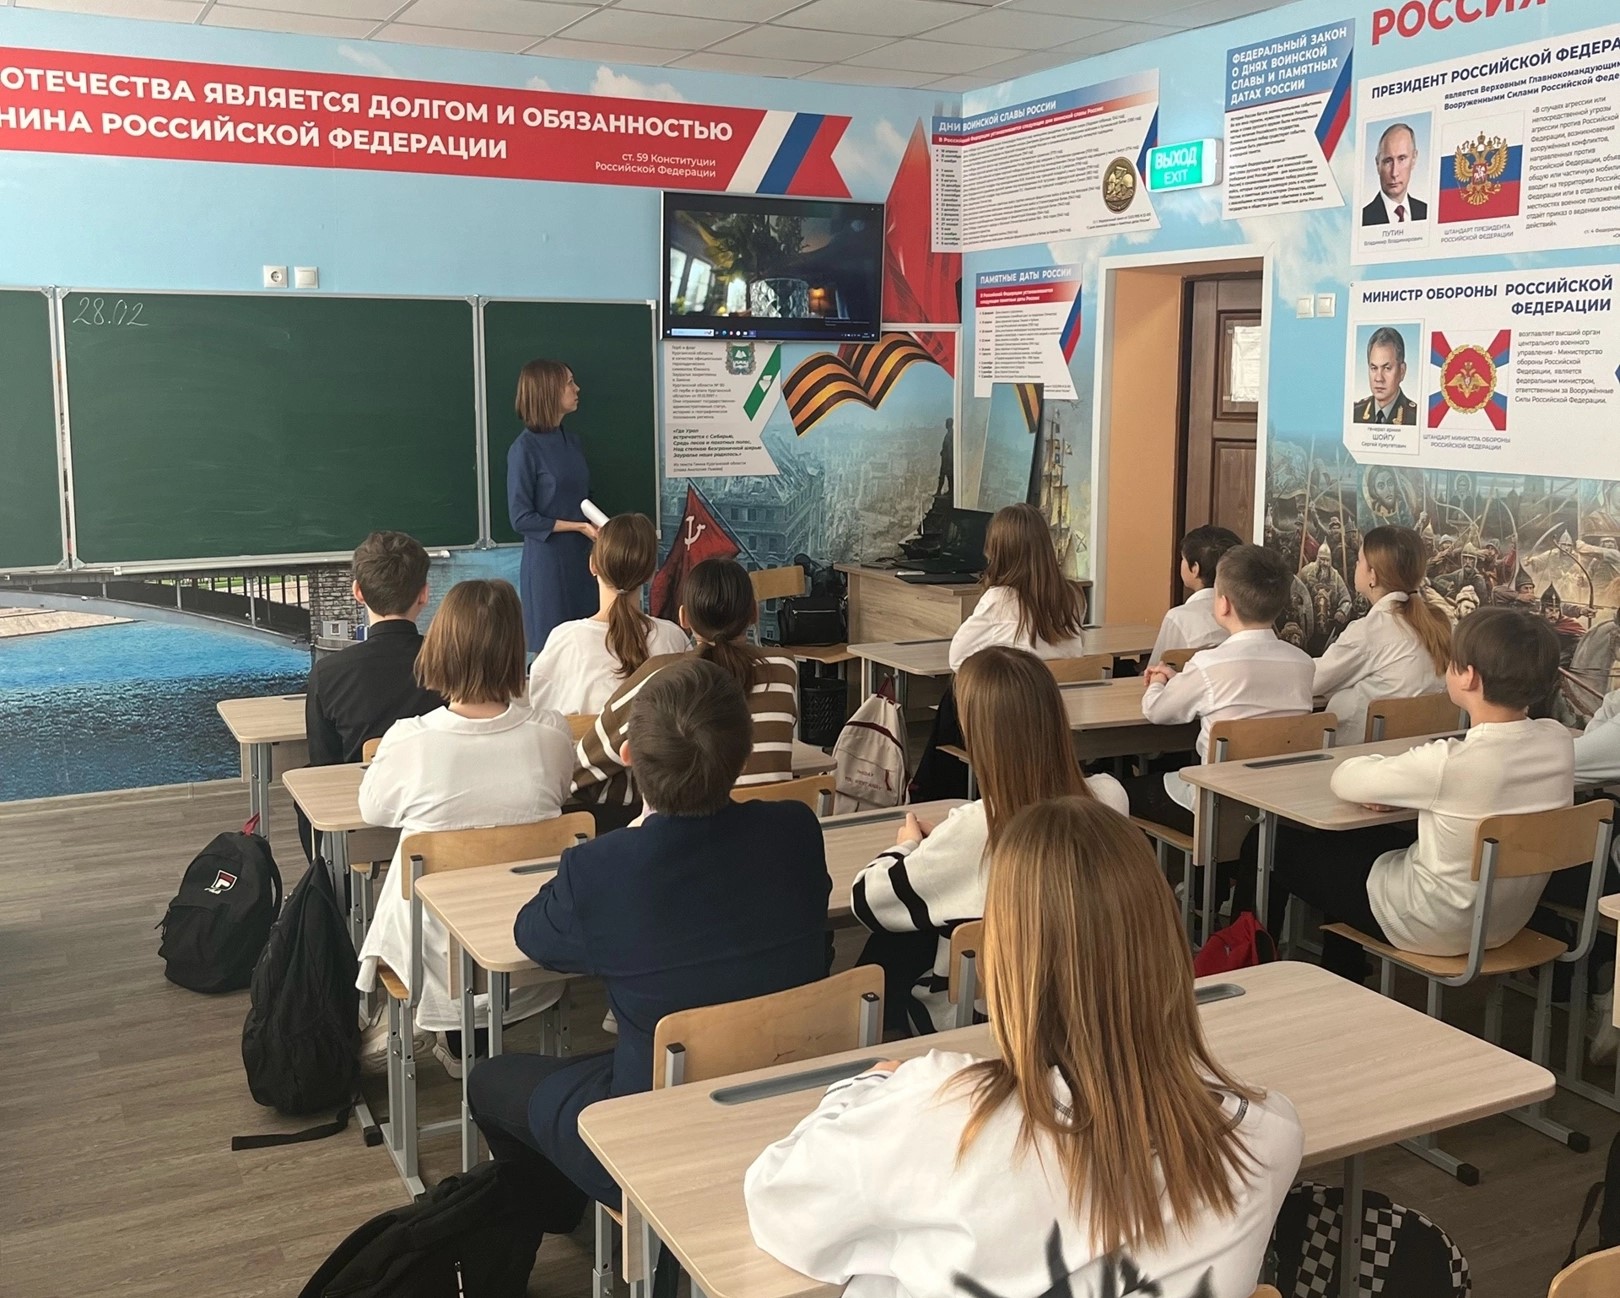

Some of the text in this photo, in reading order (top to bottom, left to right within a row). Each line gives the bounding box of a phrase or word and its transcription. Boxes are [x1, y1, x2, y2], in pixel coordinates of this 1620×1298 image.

[1372, 0, 1546, 45] РОССИ
[1232, 27, 1347, 63] ФЕДЕРАЛЬНЫЙ ЗАКОН
[1232, 44, 1327, 76] О ДНЯХ ВОИНСКОЙ
[1372, 72, 1448, 99] ПРЕЗИДЕНТ
[1451, 48, 1551, 83] РОССИЙСКОЙ
[1231, 57, 1338, 91] СЛАВЫ И ПАМЯТНЫХ
[1507, 87, 1539, 98] Силами
[1541, 76, 1593, 92] Российской
[1231, 79, 1305, 105] ДАТАХ РОССИИ
[1445, 87, 1478, 100] является
[1480, 79, 1527, 93] Верховным
[1, 66, 733, 141] ОТЕЧЕСТВА ЯВЛЯЕТСЯ ДОЛГОМ И ОБЯЗАННОСТЬЮ
[939, 100, 1056, 132] ДНИ ВОИНСКОЙ СЛАВЫ РОССИИ
[102, 113, 320, 147] РОССИЙСКОЙ
[328, 128, 507, 160] ФЕДЕРАЦИИ
[595, 161, 716, 179] Российской Федерации
[621, 153, 716, 168] ст. 59 Конституции
[1155, 147, 1197, 169] ВЫХОД
[1164, 169, 1188, 184] EXIT
[1382, 229, 1404, 237] ПУТИН
[980, 268, 1071, 284] ПАМЯТНЫЕ ДАТЫ РОССИИ
[1363, 275, 1613, 303] МИНИСТР ОБОРОНЫ РОССИЙСКОЙ
[72, 297, 149, 327] 28.02
[1511, 298, 1611, 316] ФЕДЕРАЦИИ
